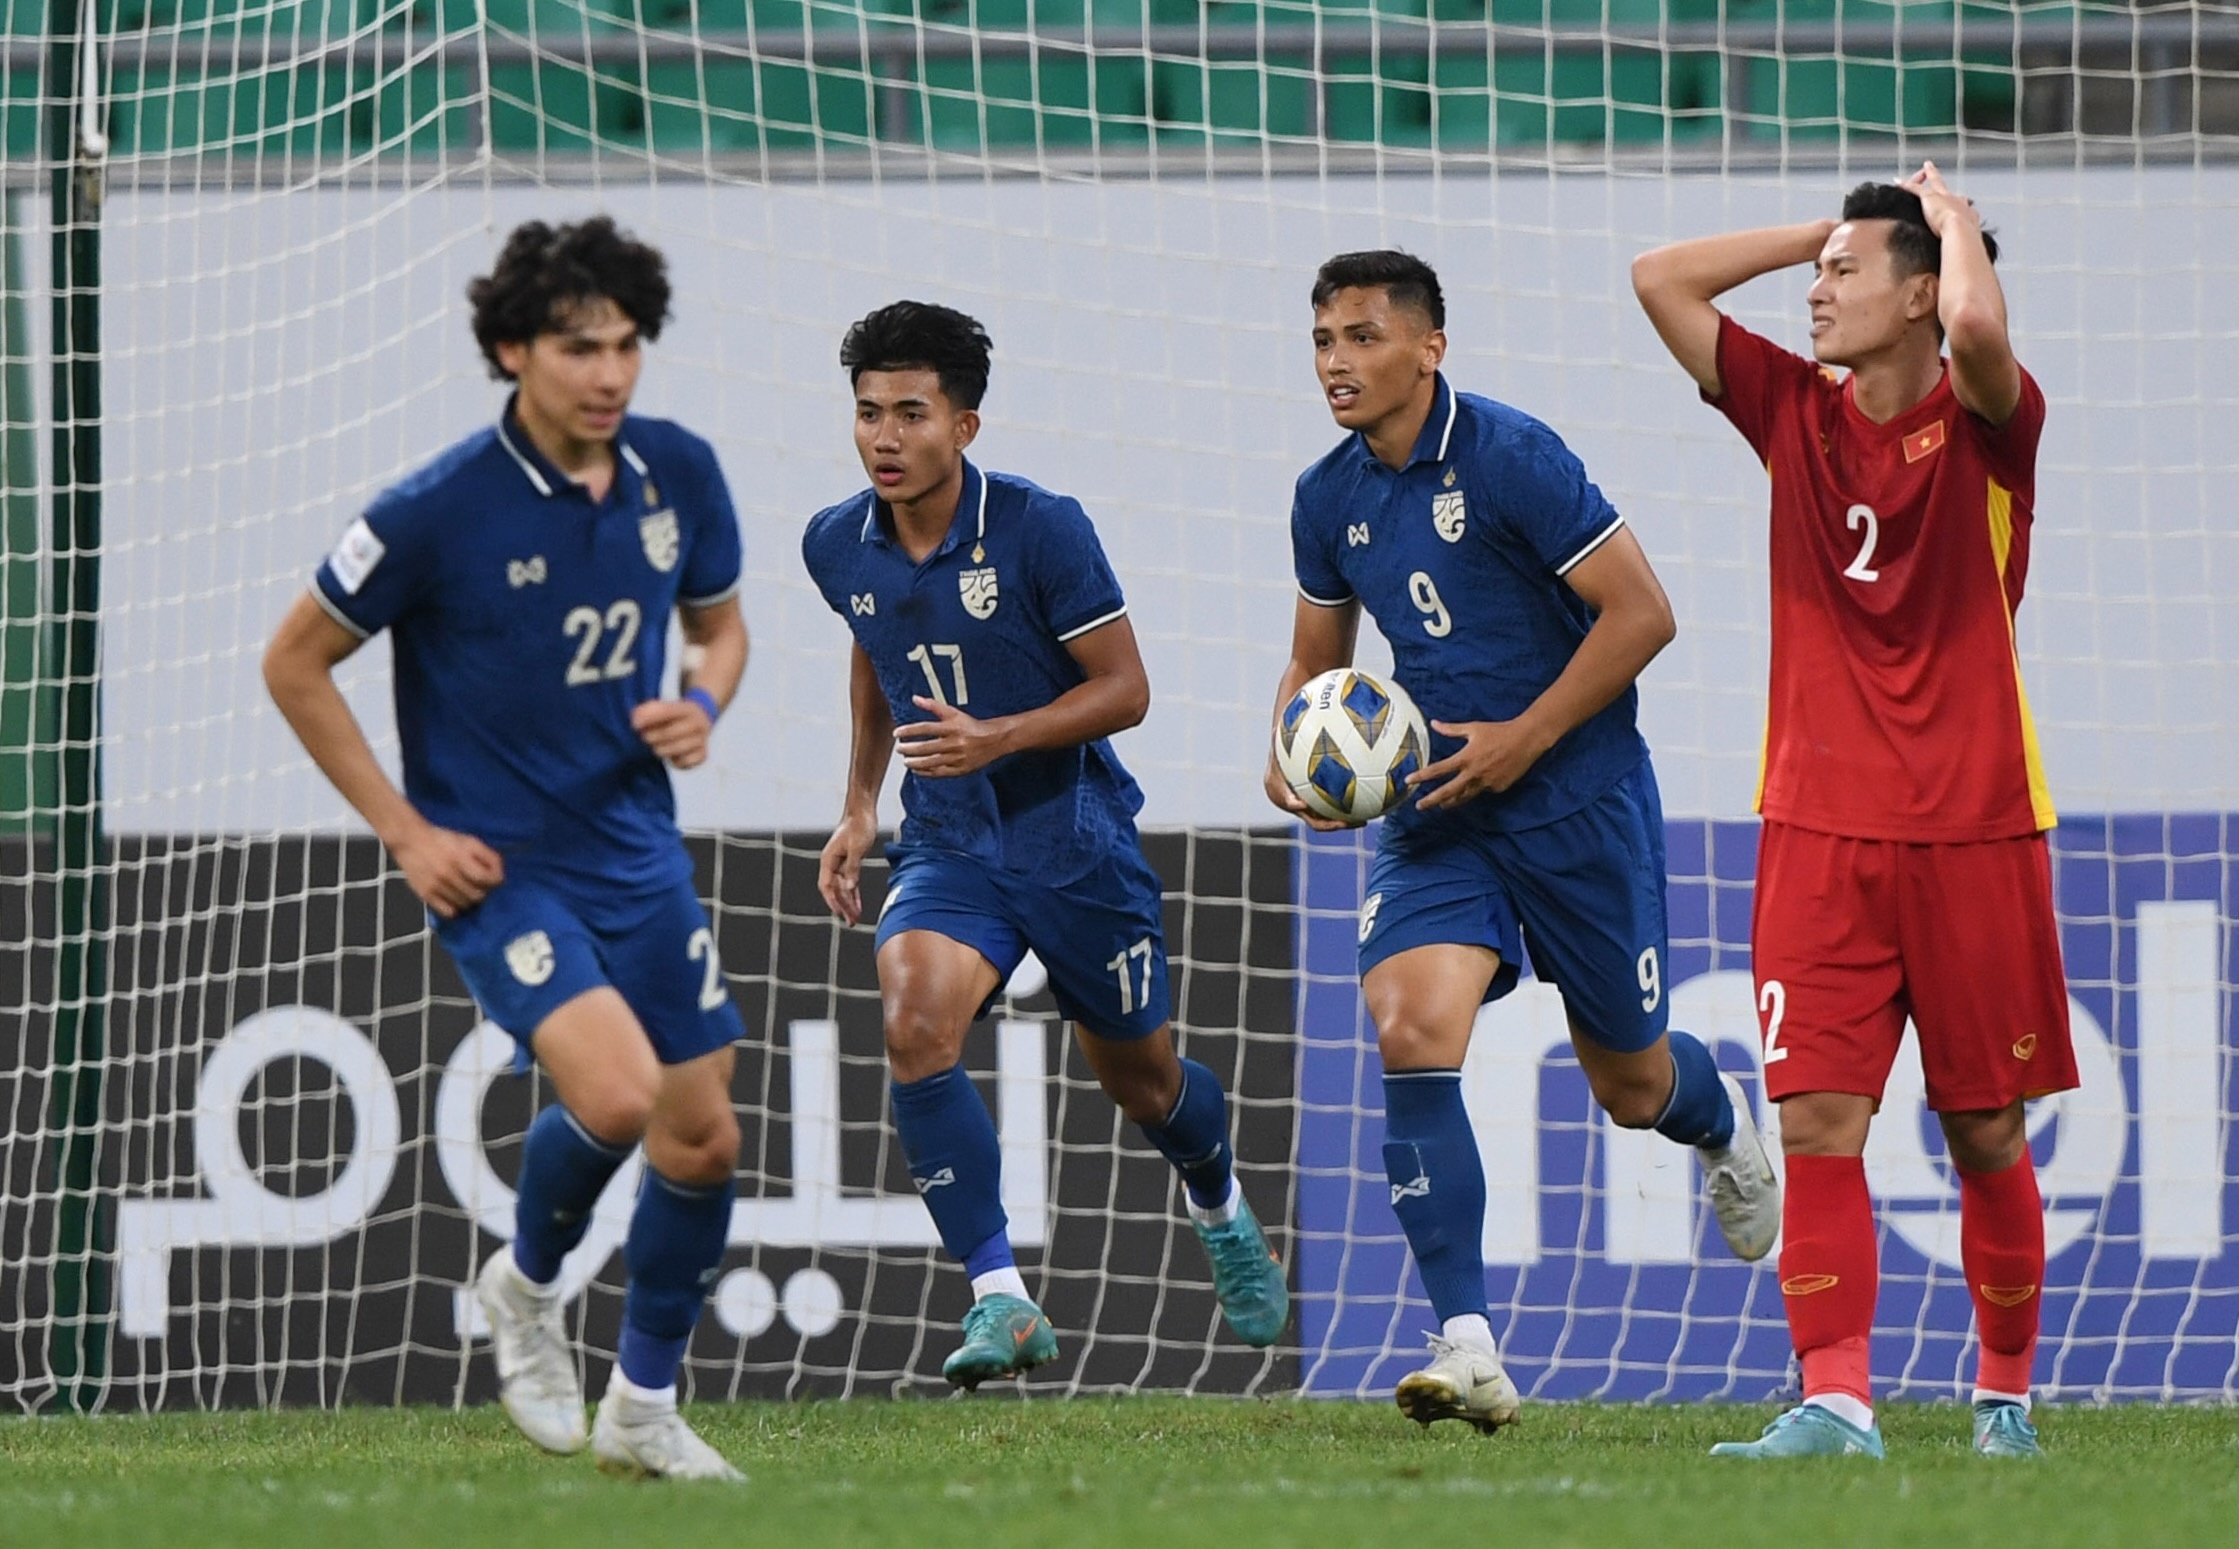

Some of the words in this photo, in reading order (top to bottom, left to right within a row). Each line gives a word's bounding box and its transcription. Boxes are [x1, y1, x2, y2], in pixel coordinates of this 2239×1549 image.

[1843, 504, 1879, 582] 2
[563, 599, 641, 687] 22
[1408, 571, 1452, 638] 9
[906, 644, 968, 706] 17
[1106, 936, 1152, 1014] 17
[1637, 946, 1661, 1013] 9
[1759, 980, 1788, 1064] 2
